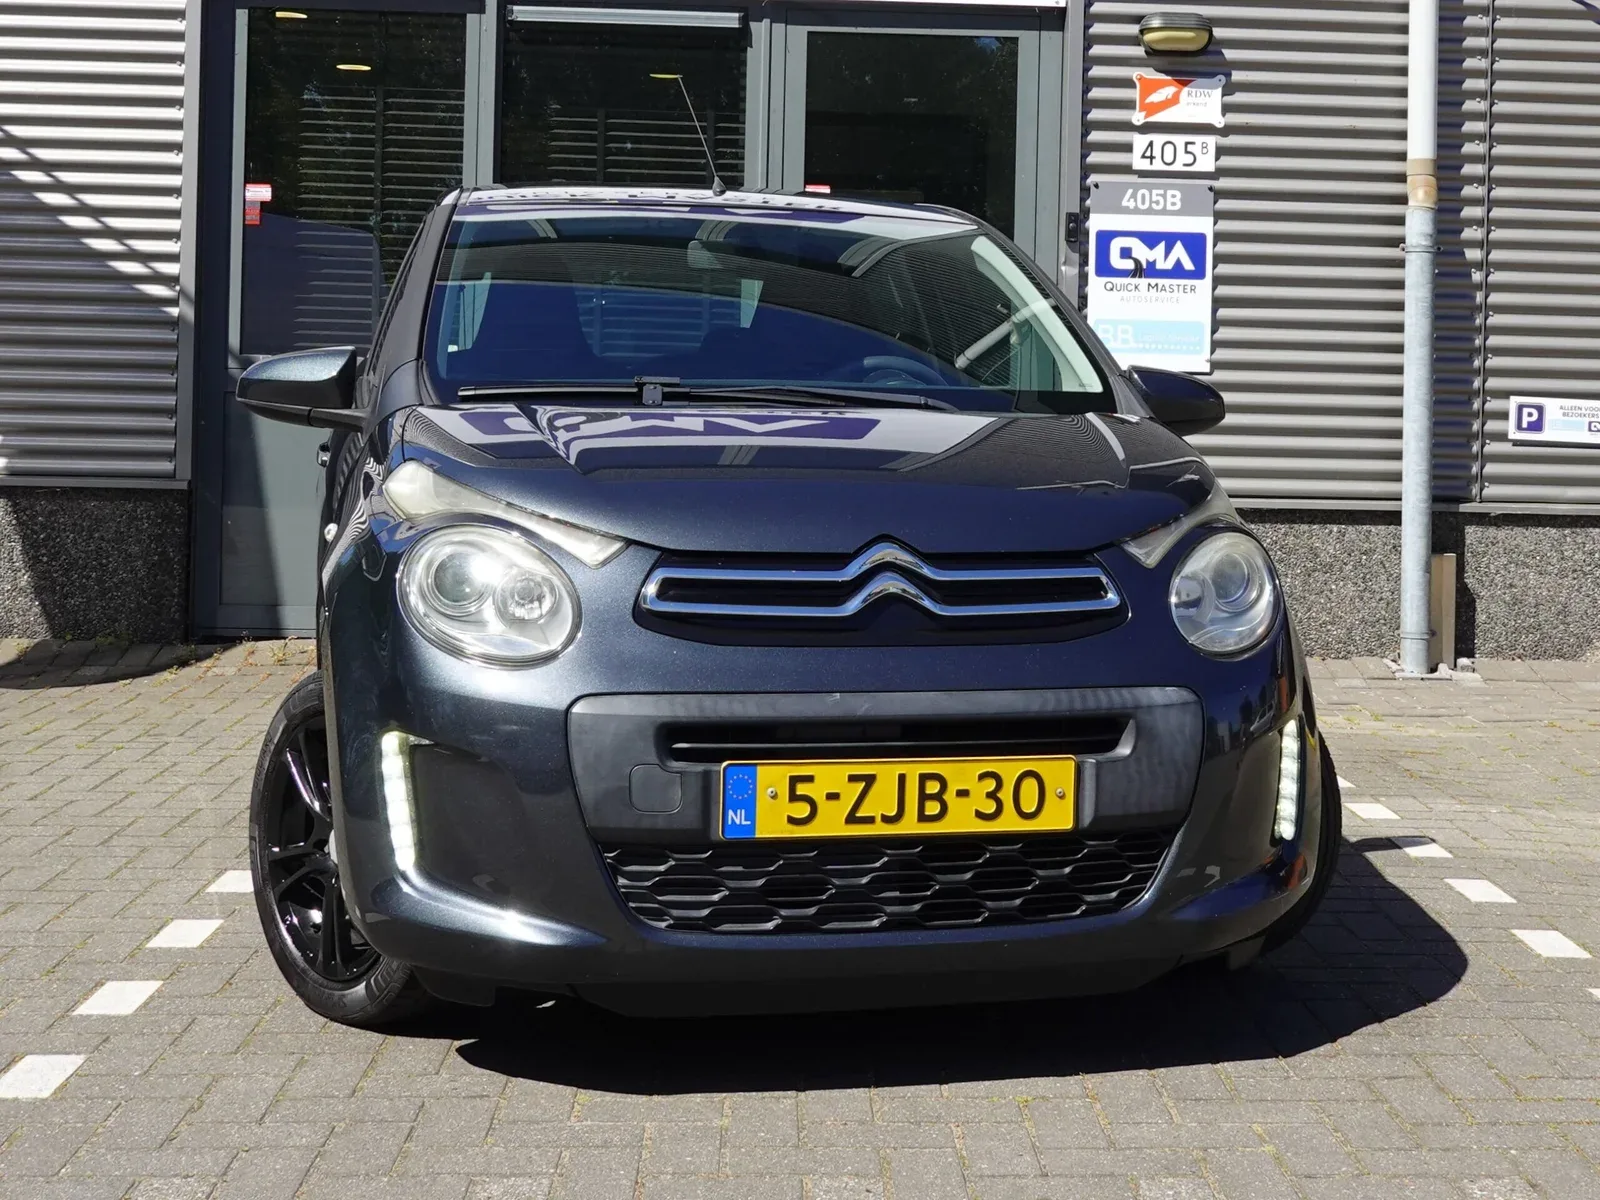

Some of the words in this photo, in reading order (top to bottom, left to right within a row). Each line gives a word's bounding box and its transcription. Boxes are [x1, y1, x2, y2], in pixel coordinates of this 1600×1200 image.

[1187, 89, 1213, 98] RDW
[1121, 188, 1181, 211] 405B
[1110, 236, 1195, 271] QMA
[1104, 281, 1141, 293] QUICK
[1147, 282, 1197, 294] MASTER
[1120, 296, 1180, 304] AUTOSERVICE
[1521, 407, 1539, 429] P
[728, 809, 751, 825] NL
[786, 769, 1047, 826] 5-ZJB-30
